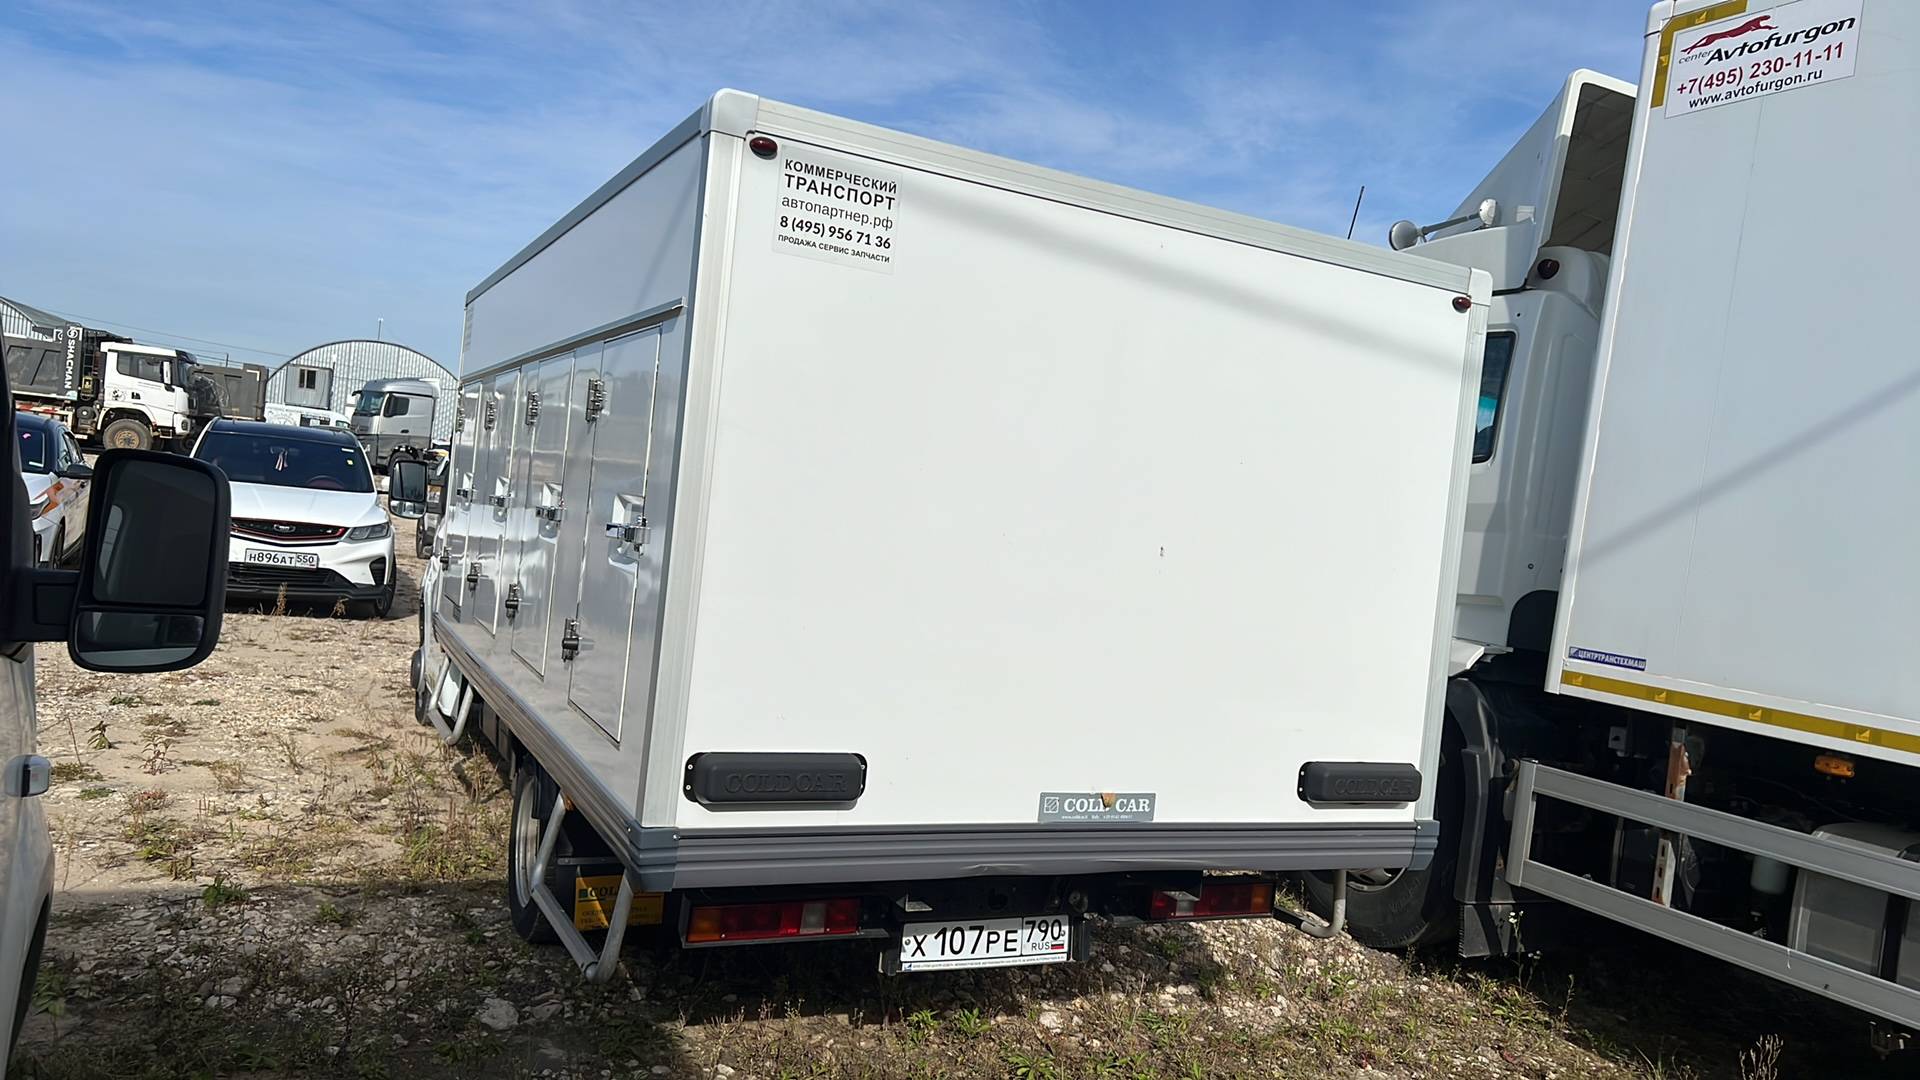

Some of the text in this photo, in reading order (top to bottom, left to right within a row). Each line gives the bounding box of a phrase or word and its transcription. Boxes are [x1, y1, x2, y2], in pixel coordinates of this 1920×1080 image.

[1704, 17, 1856, 65] Avtofurgon
[1677, 42, 1844, 95] +7(495) 230-11-11
[1689, 70, 1823, 109] www.avtofurgon.ru
[784, 173, 896, 210] ТРАНСПОРТ
[785, 159, 897, 194] КОММЕРЧЕСКИЙ
[781, 196, 893, 231] автопартнер.рф
[778, 234, 890, 263] ПРОДАЖА СЕРВИС ЗАПЧАСТИ
[780, 216, 891, 249] 8 (495) 956 71 36
[64, 339, 76, 389] SHACMAN
[1115, 798, 1150, 812] CAR
[1025, 919, 1062, 943] 790
[1031, 942, 1050, 951] RUS
